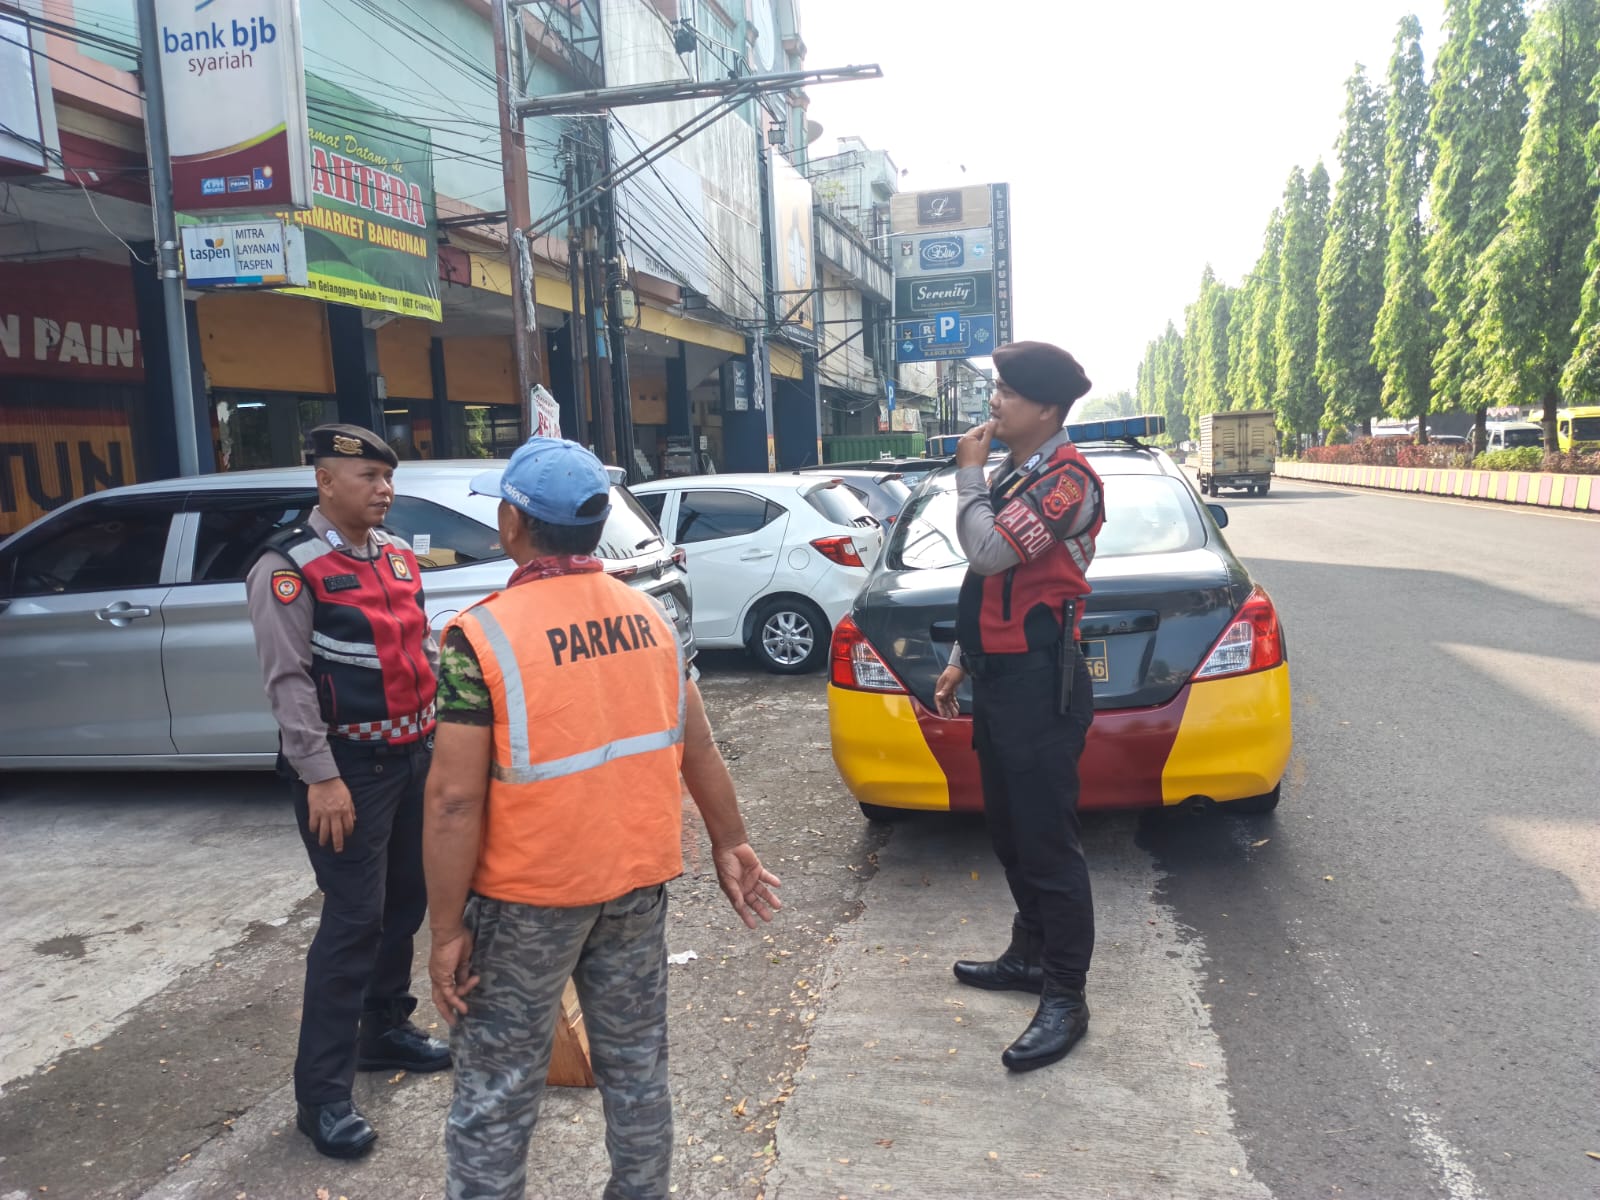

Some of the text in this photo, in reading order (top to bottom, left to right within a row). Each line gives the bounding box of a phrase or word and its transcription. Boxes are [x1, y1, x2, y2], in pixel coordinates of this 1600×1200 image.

[163, 16, 276, 53] bank bjb
[188, 49, 253, 76] syariah
[308, 128, 340, 149] amat
[345, 134, 388, 171] Datang
[312, 146, 426, 228] AHTERA
[235, 228, 265, 239] MITRA
[287, 206, 428, 258] ERMARKET BANGUNAN
[190, 247, 231, 262] taspen
[236, 243, 280, 255] LAYANAN
[238, 259, 273, 271] TASPEN
[917, 286, 969, 300] Serenity
[940, 316, 955, 338] P
[34, 317, 144, 368] PAIN
[546, 614, 658, 666] PARKIR
